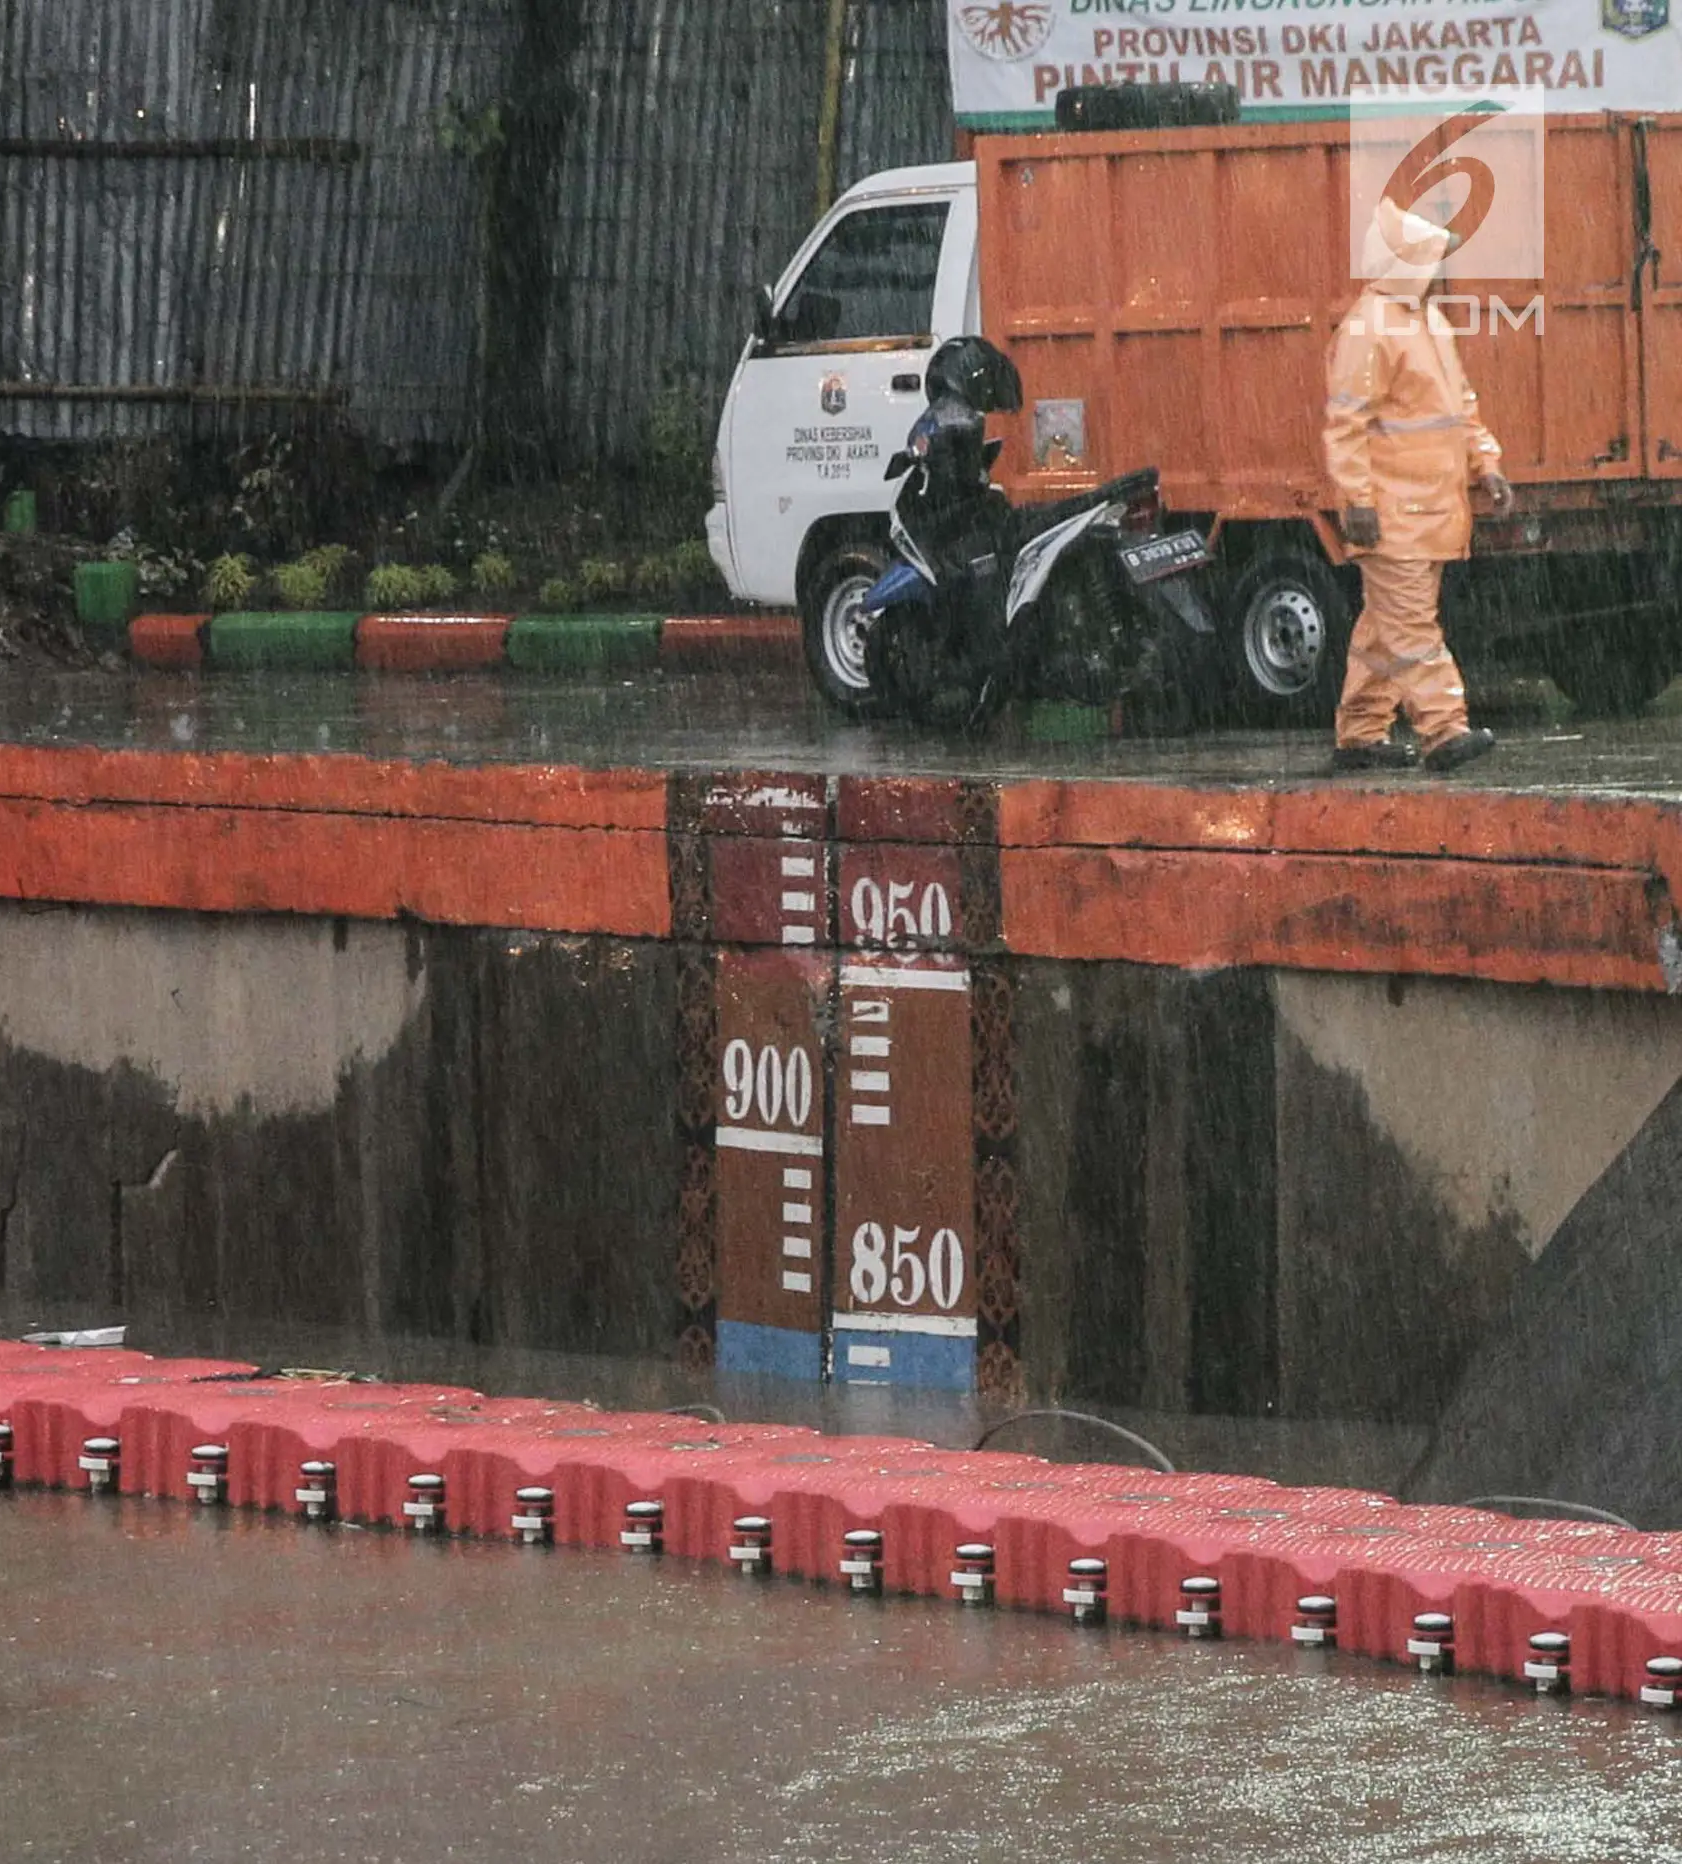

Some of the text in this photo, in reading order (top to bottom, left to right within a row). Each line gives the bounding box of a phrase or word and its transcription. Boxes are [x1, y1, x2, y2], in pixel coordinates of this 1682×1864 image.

[1093, 16, 1543, 58] PROVINSI DKI JAKARTA
[1033, 49, 1605, 103] PINTU AIR MANGGARAI
[794, 426, 818, 443] DINAS
[850, 877, 954, 964] 950
[723, 1038, 812, 1127] 900
[849, 1221, 965, 1310] 850
